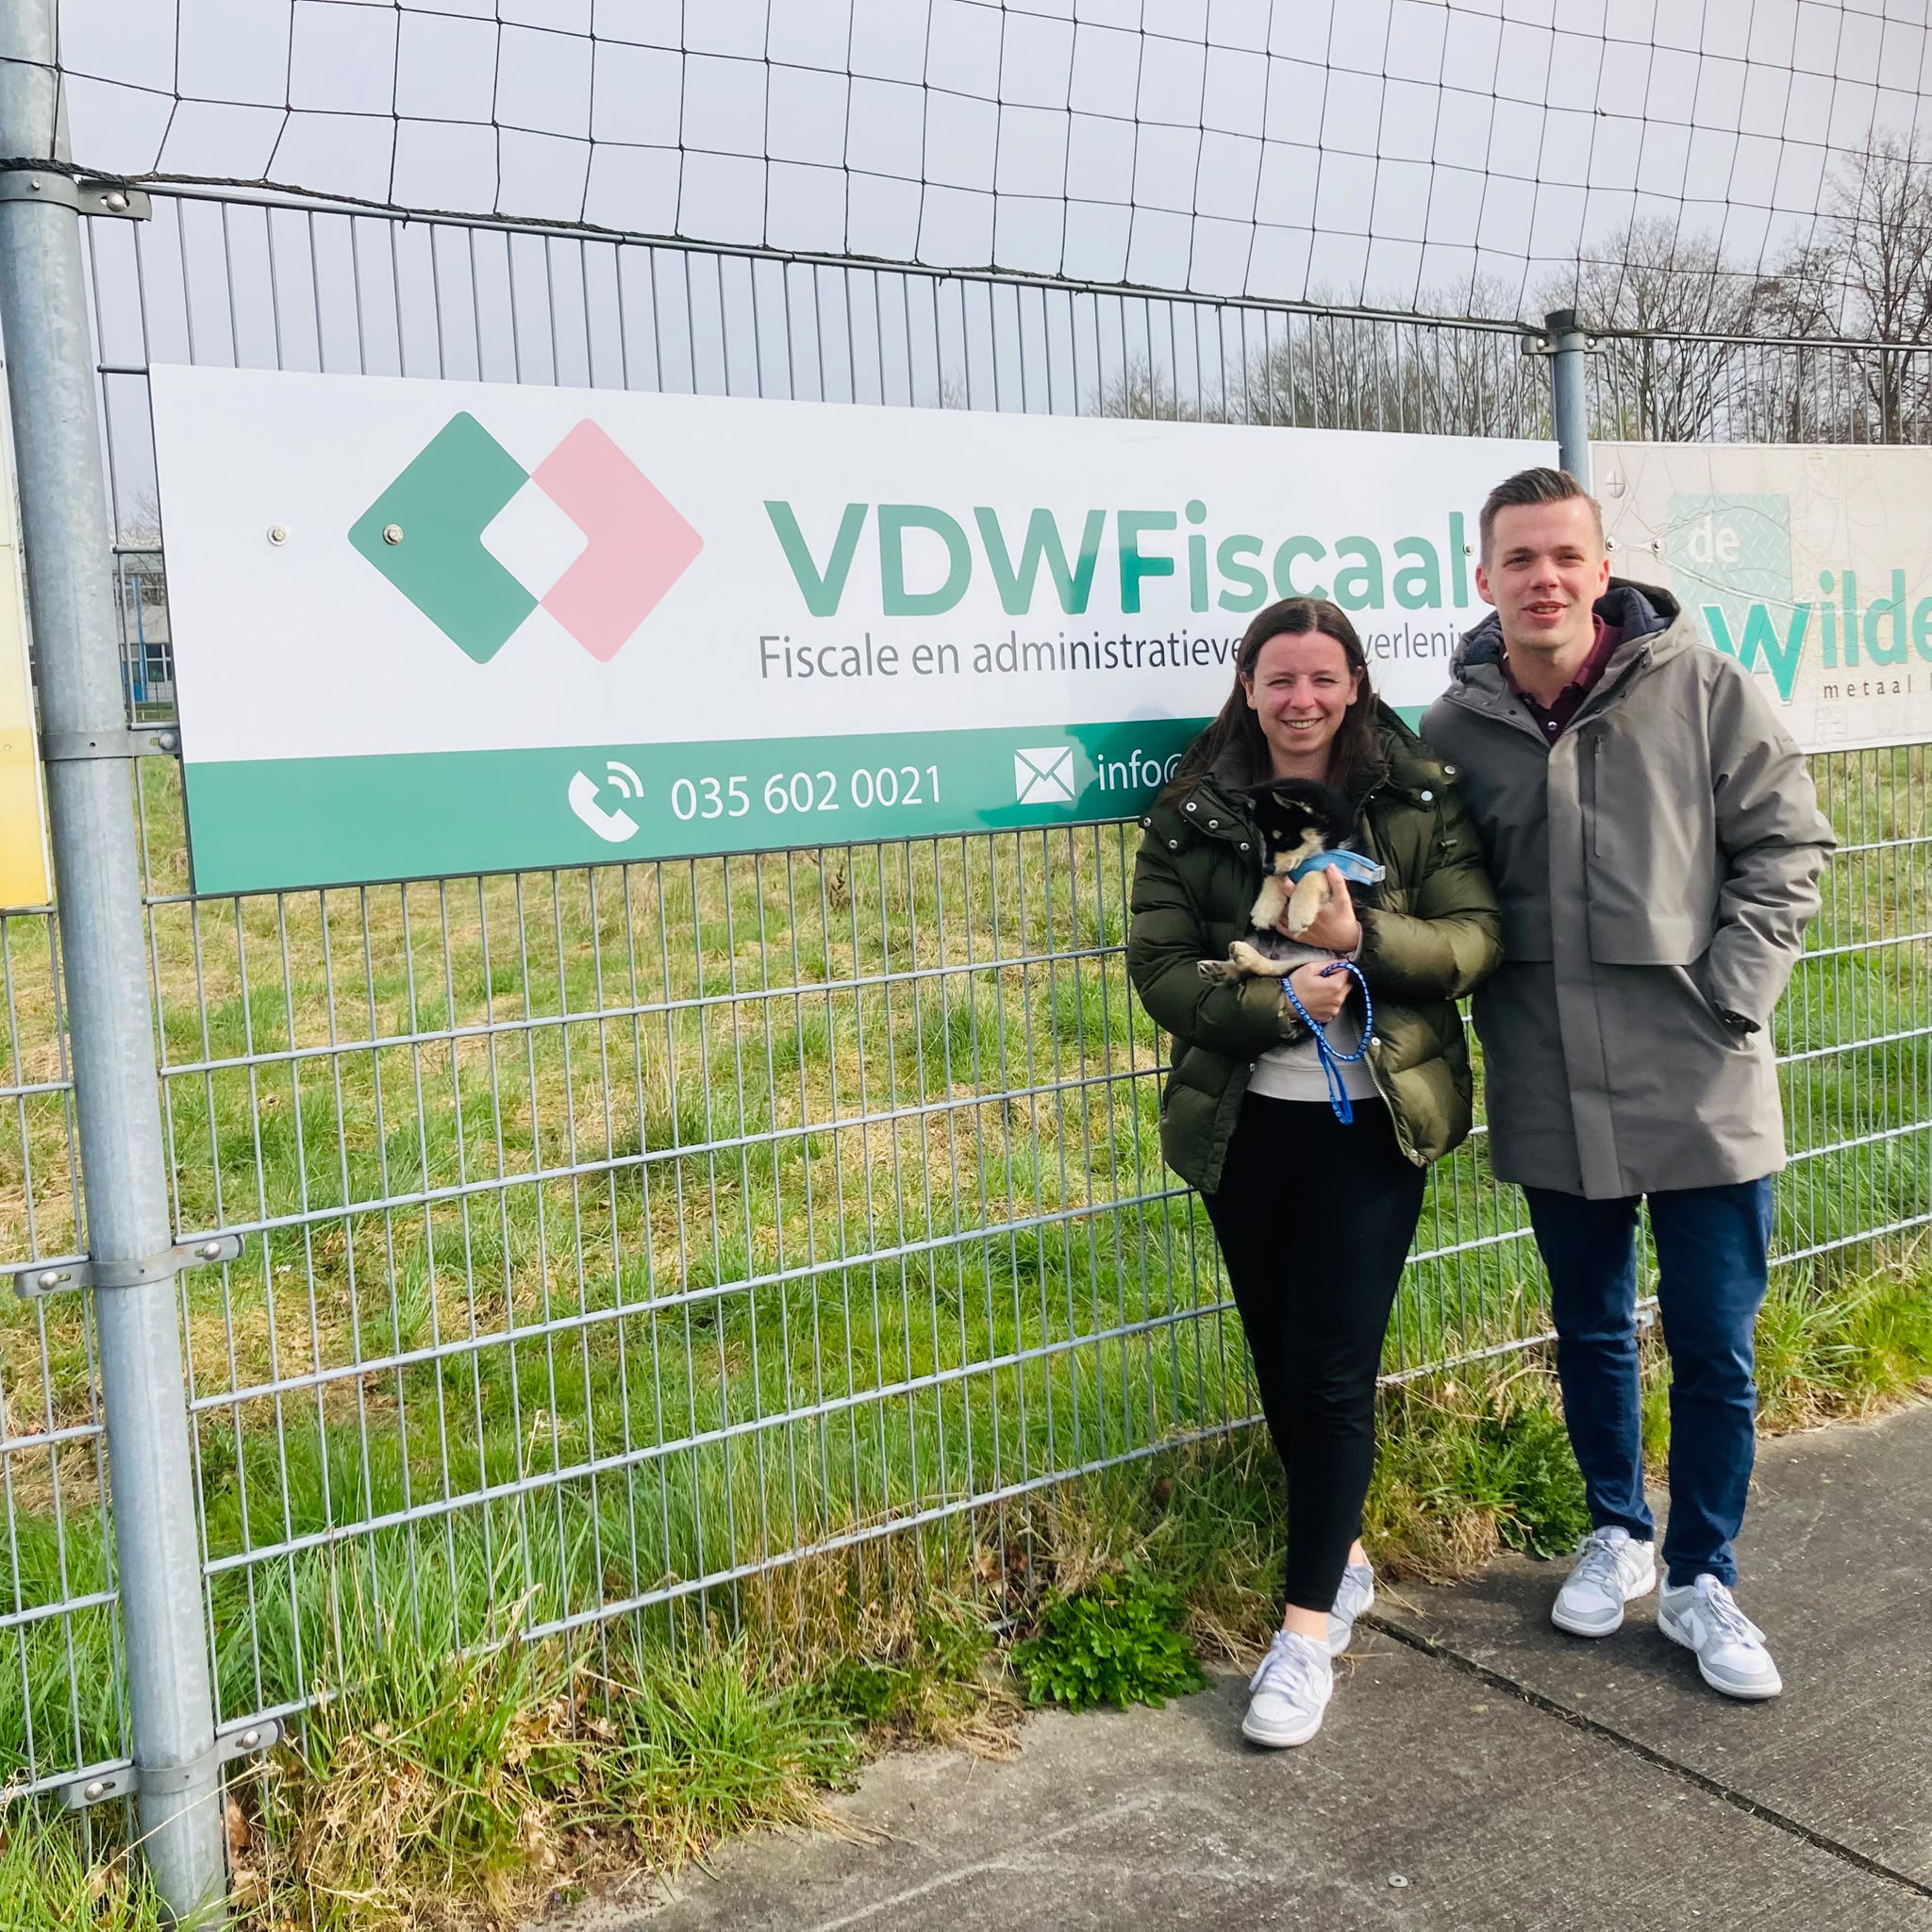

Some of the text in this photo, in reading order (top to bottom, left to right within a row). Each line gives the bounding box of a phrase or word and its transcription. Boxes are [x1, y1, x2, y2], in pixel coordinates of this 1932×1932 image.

[763, 499, 1469, 618] VDWFiscaal
[1689, 512, 1742, 564] de
[759, 632, 899, 679] Fiscale
[912, 643, 960, 675] en
[1824, 673, 1911, 699] metaal
[671, 764, 941, 821] 035 602 0021
